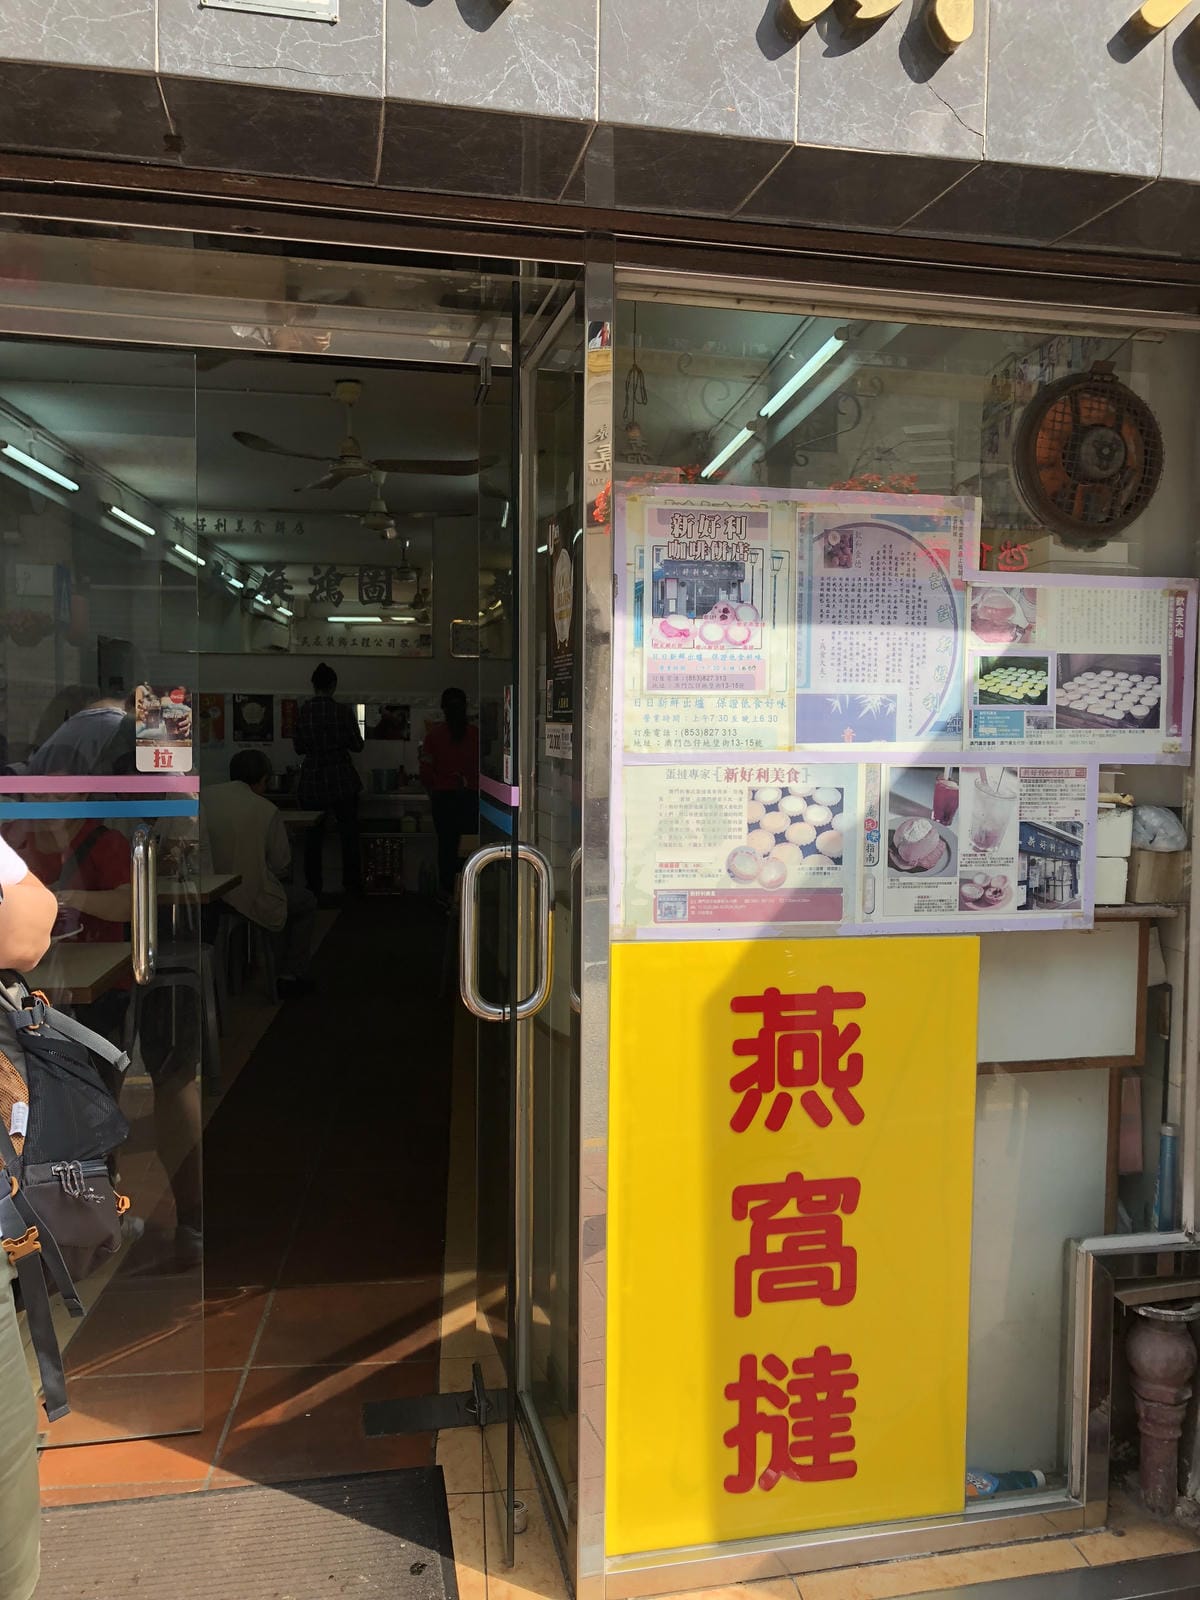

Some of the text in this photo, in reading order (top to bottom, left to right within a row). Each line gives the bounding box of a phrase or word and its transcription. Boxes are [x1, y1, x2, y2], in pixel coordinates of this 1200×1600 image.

[671, 513, 748, 540] 新好利
[667, 539, 750, 562] 咖啡餅店
[153, 749, 174, 768] 拉
[723, 985, 867, 1494] 燕窩撻
